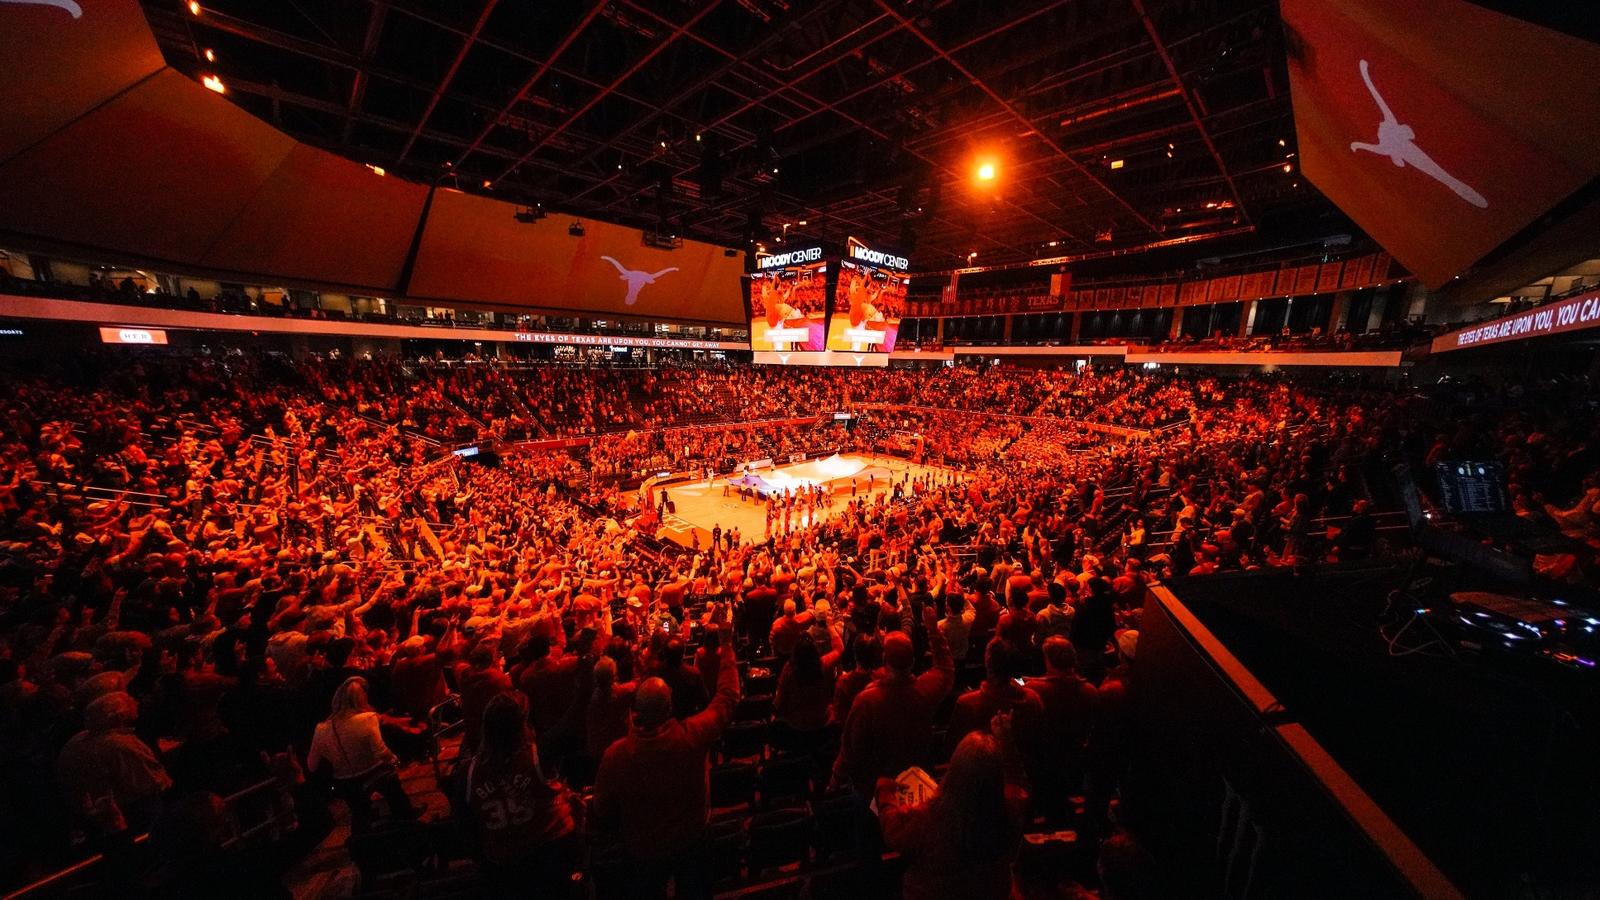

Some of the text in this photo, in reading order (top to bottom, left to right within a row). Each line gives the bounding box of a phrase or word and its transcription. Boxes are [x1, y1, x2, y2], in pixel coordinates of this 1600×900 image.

[762, 247, 822, 268] MOODY CENTER
[855, 246, 909, 270] MOODY CENTER
[1026, 297, 1059, 306] TEXAS
[1465, 331, 1476, 343] EYES
[1475, 328, 1482, 341] OF
[1483, 325, 1499, 339] TEXAS
[1499, 321, 1512, 336] ARE
[1512, 315, 1533, 334] UPON
[1534, 310, 1553, 331] YOU,
[1556, 303, 1580, 326] YOU
[514, 333, 531, 341] THE
[534, 334, 555, 342] EYES
[480, 798, 535, 830] 35
